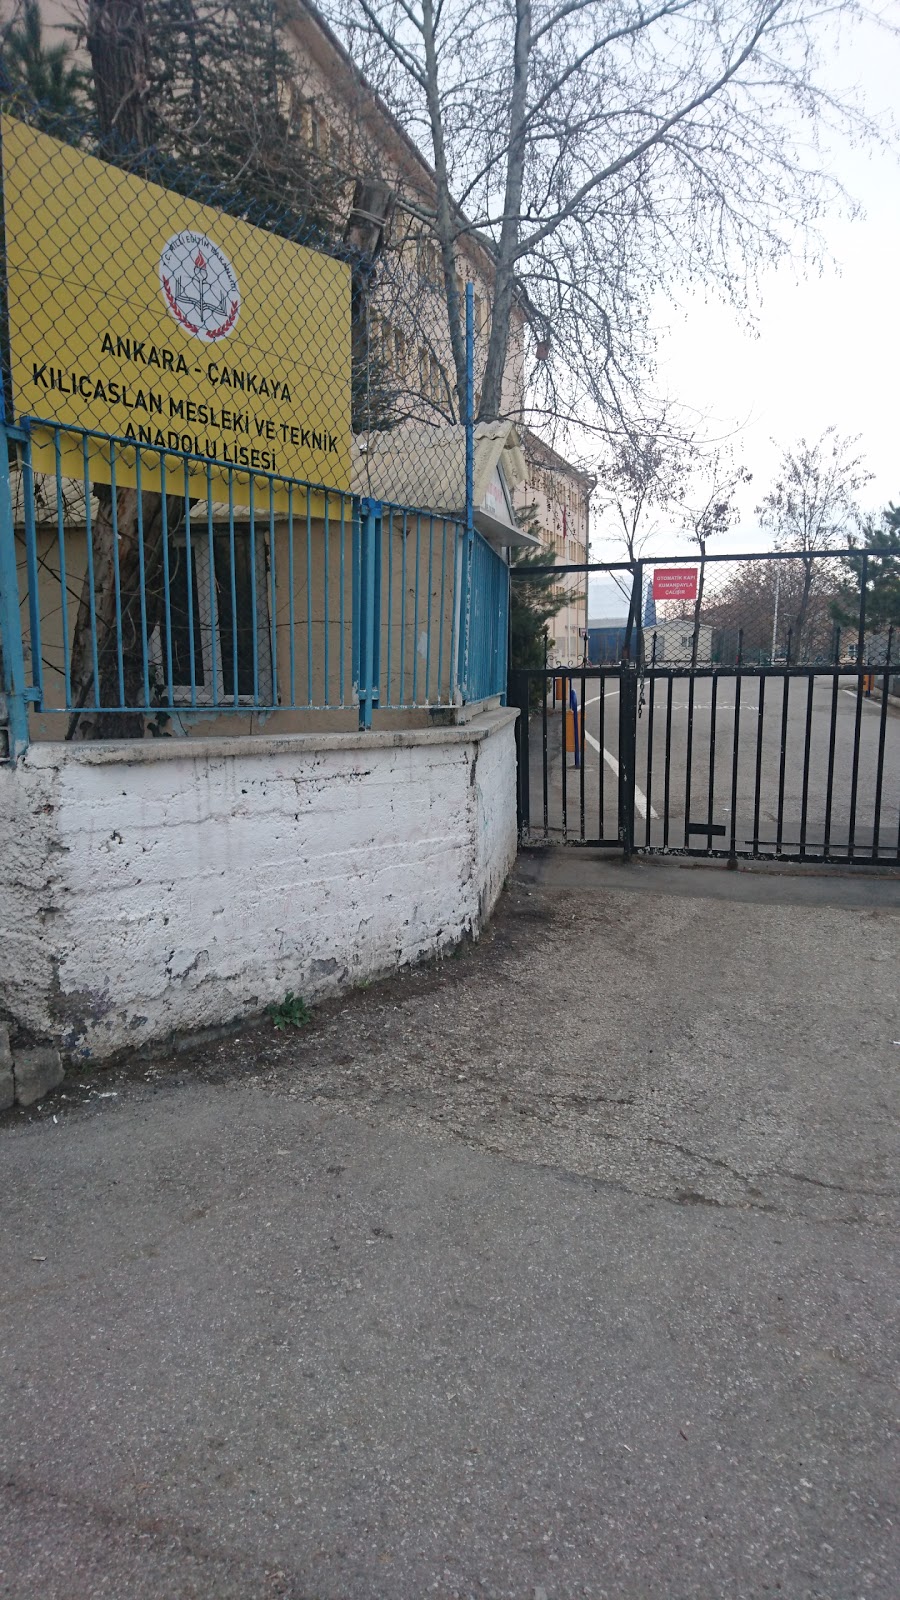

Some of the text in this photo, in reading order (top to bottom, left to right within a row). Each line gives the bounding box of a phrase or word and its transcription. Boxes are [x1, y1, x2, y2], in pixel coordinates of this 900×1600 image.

[101, 332, 189, 374] ANKARA
[208, 362, 292, 403] ÇANKAYA
[33, 363, 339, 454] KILIÇASLAN MESLEKİ VE TEKNİK
[124, 422, 277, 471] ANADOLU LİSESİ
